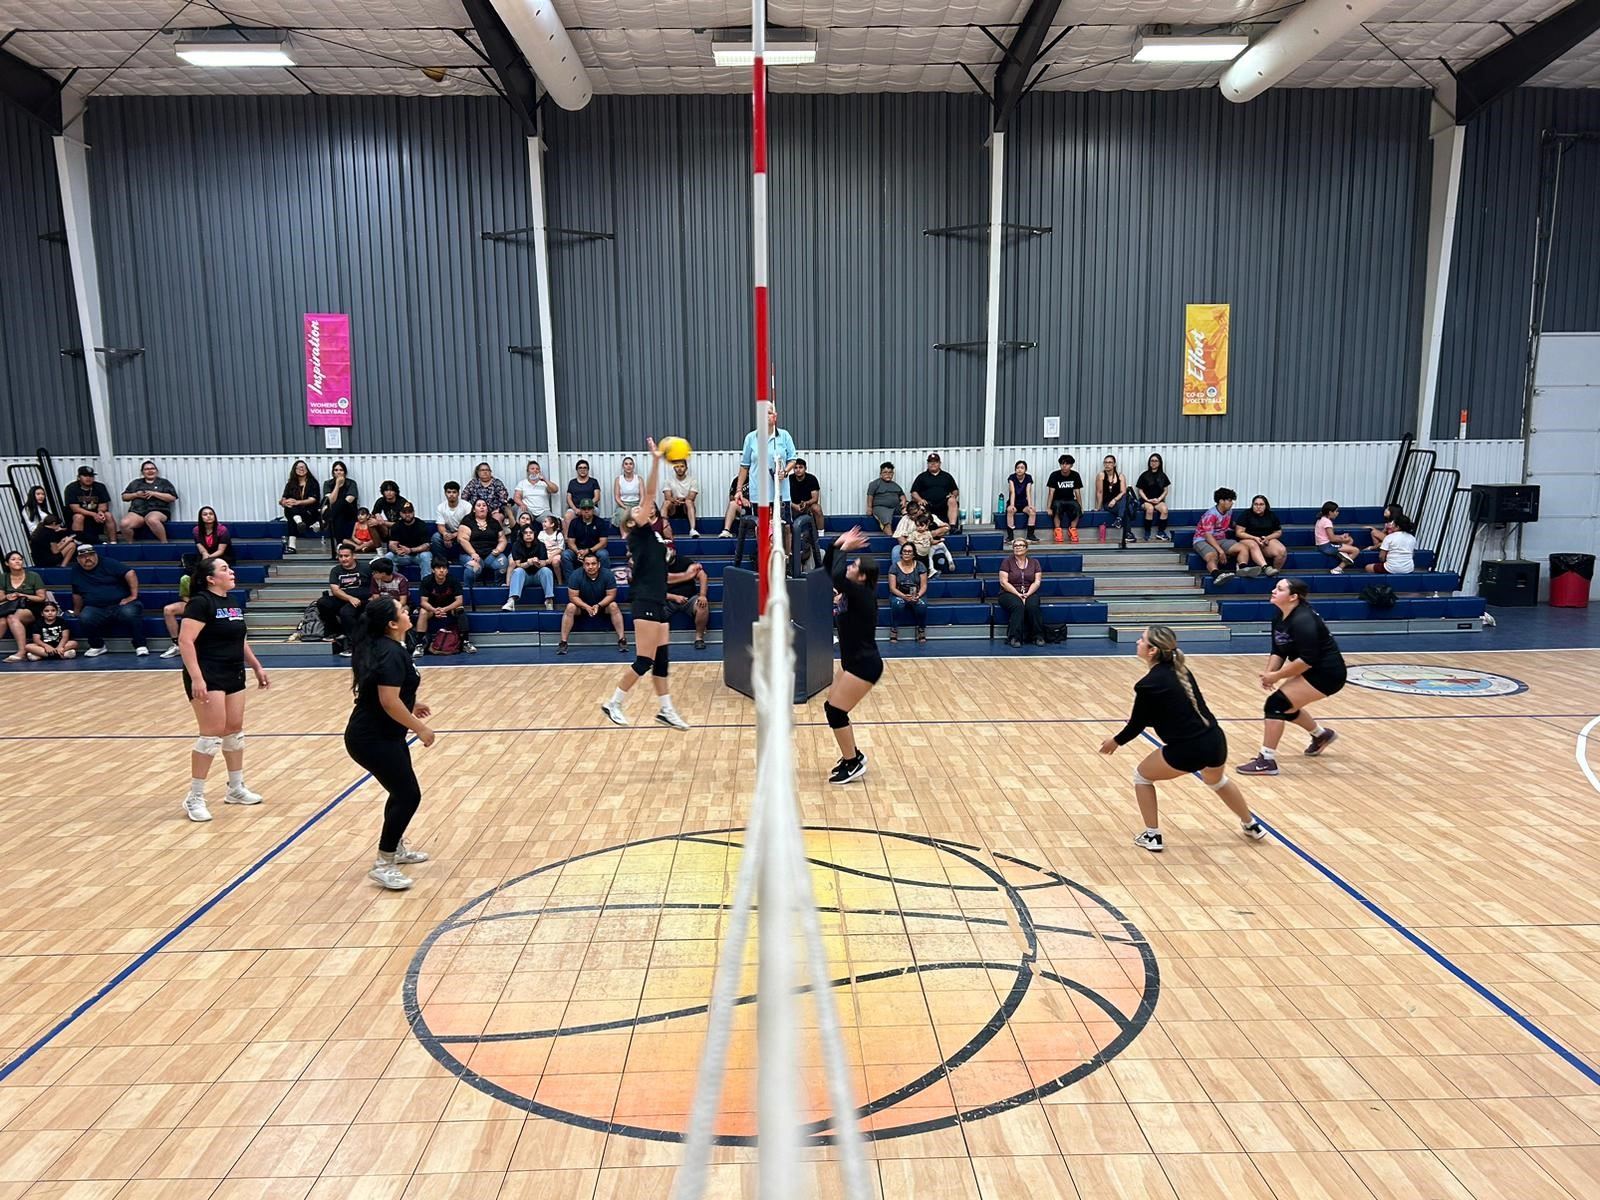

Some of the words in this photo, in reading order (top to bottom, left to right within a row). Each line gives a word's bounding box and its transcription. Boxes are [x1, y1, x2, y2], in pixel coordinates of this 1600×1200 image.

[307, 319, 326, 396] Inspiration
[1187, 328, 1206, 381] Effort
[1057, 481, 1075, 489] VANS
